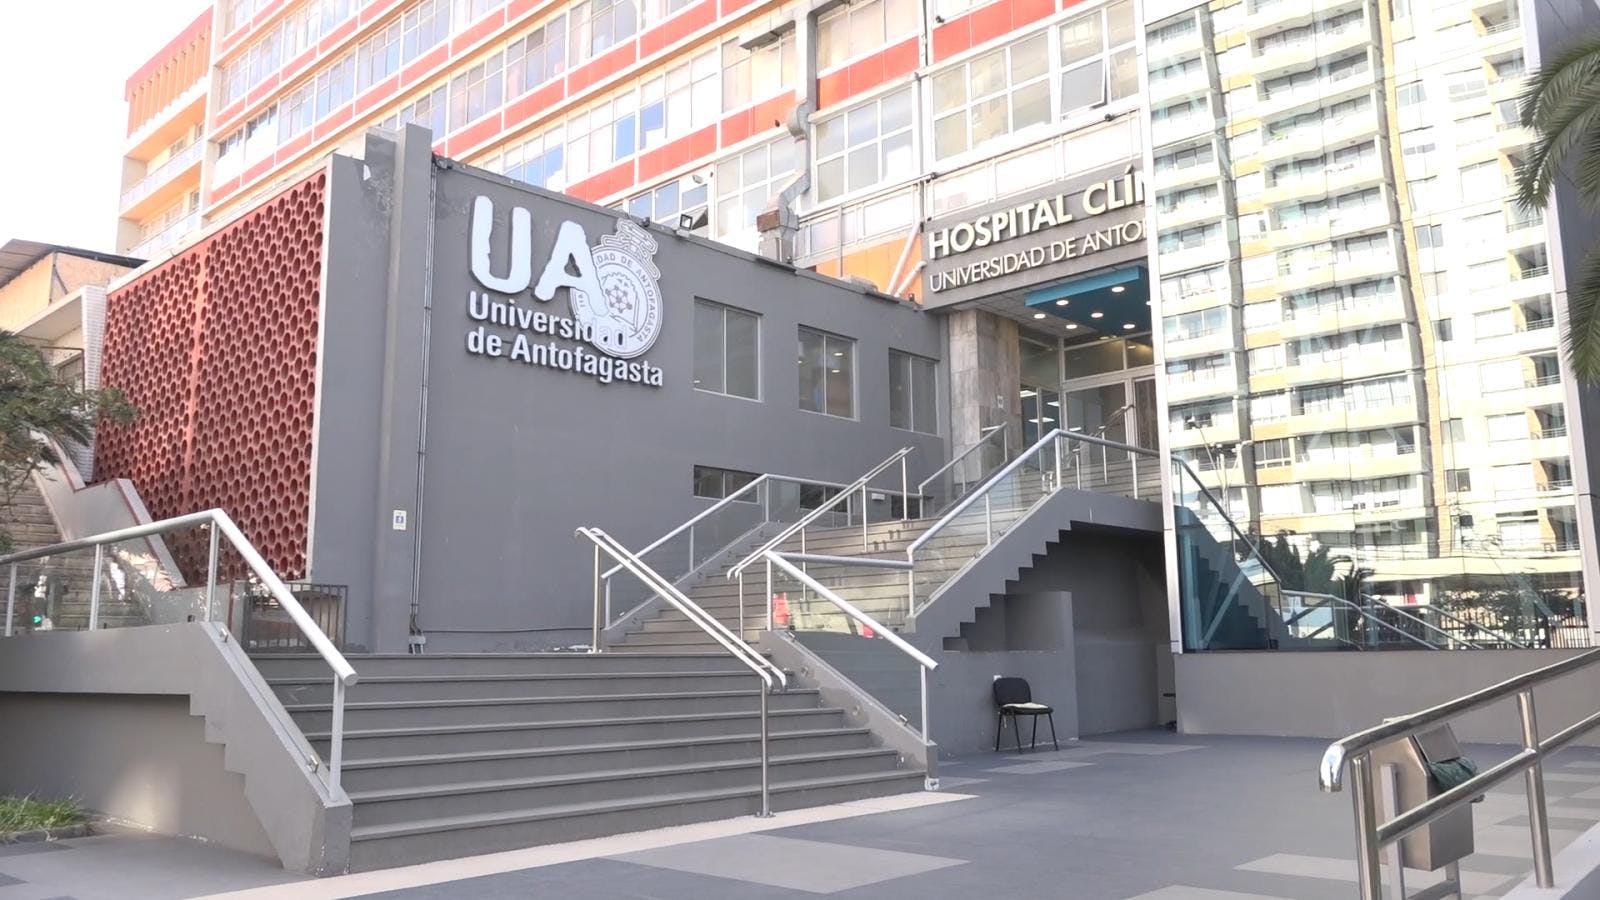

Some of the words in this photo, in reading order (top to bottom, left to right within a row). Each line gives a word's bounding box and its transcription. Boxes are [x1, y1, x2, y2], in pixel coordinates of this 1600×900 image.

[471, 195, 609, 317] UA
[929, 195, 1072, 260] HOSPITAL
[930, 246, 1045, 293] UNIVERSIDAD
[1051, 237, 1076, 262] DE
[469, 290, 627, 349] Universidad
[468, 327, 502, 357] de
[511, 333, 663, 387] Antofagasta
